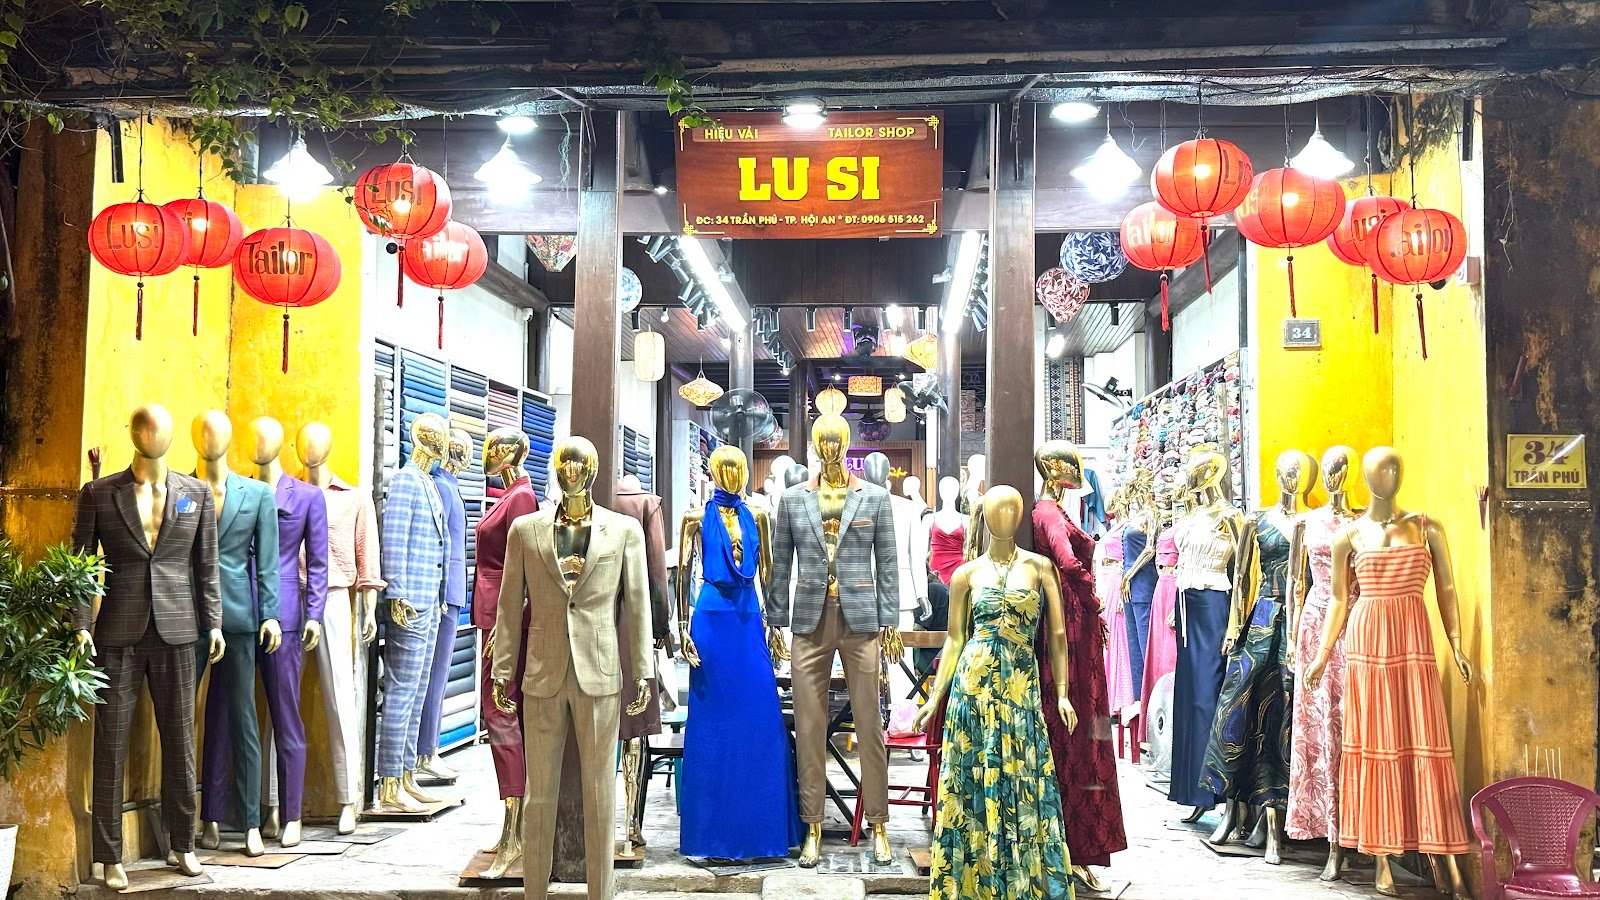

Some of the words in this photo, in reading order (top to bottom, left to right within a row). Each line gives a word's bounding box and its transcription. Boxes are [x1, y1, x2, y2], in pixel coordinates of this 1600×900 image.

[737, 125, 758, 139] VẢI
[827, 127, 874, 138] TAILOR
[879, 126, 915, 138] SHOP
[738, 156, 810, 200] LU
[826, 156, 880, 200] SI
[371, 172, 423, 206] Lusi
[696, 216, 714, 225] ĐC:
[715, 215, 729, 225] 34
[758, 213, 778, 225] PHÚ
[785, 215, 798, 224] TP.
[800, 213, 819, 227] HỘI
[820, 215, 836, 224] AN
[845, 215, 860, 224] ĐT:
[861, 215, 886, 224] 0906
[888, 215, 904, 224] 515
[906, 214, 925, 224] 262
[106, 215, 160, 249] Lusi
[245, 241, 313, 275] Tailor
[1291, 327, 1312, 339] 34
[1523, 440, 1569, 465] 34
[1552, 468, 1580, 484] PHÚ
